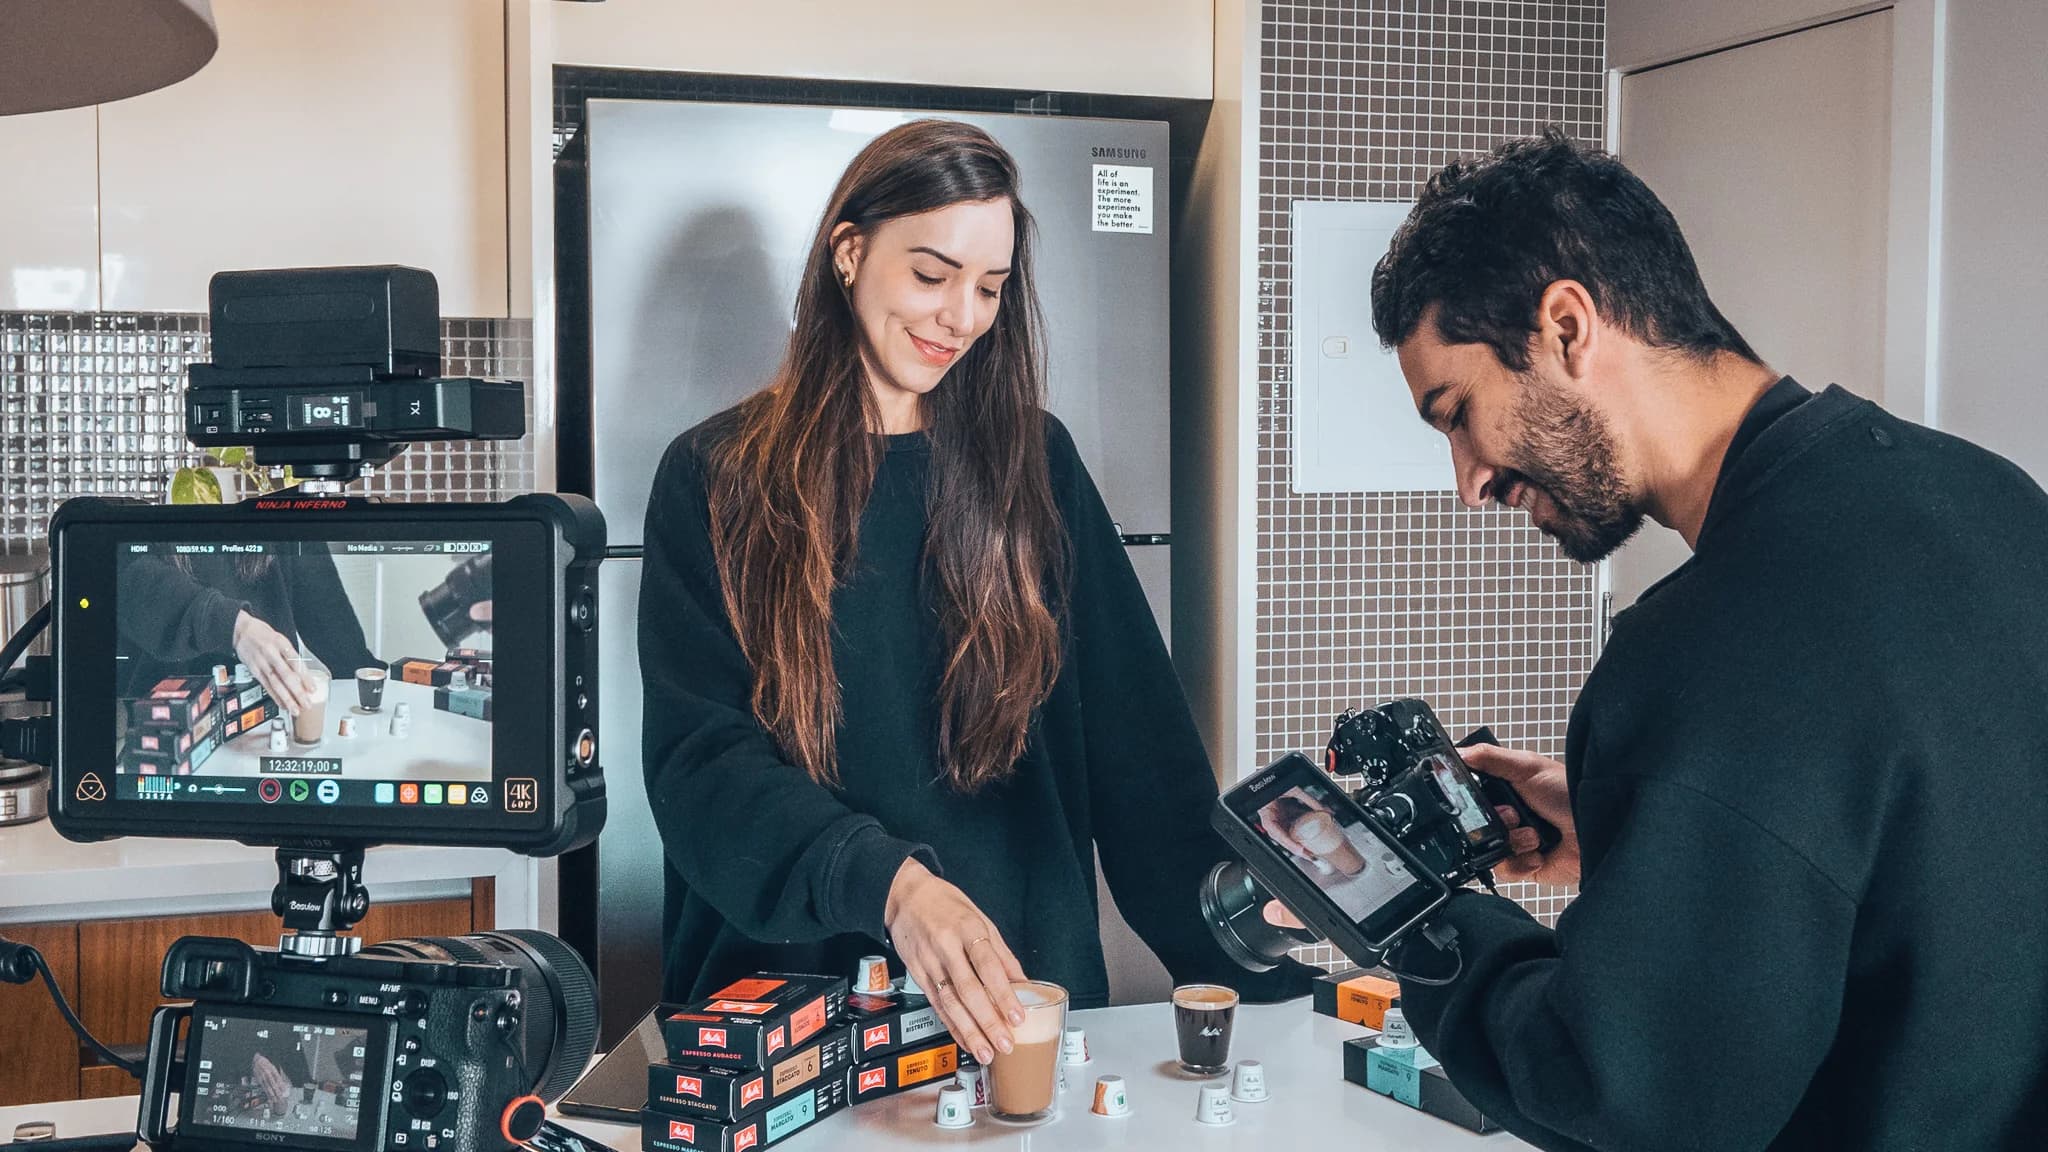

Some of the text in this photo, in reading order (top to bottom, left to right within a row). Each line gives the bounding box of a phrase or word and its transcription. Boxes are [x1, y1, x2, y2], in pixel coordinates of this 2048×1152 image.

[1091, 147, 1147, 159] SAMSUNG
[410, 400, 420, 416] TX
[256, 500, 347, 509] NINJA INFERNO
[510, 784, 531, 799] 4K
[360, 996, 378, 1005] MENU
[906, 1020, 933, 1032] RISTRETTO
[406, 1041, 416, 1050] Fn
[682, 1049, 711, 1057] ESPRESSO
[808, 1061, 813, 1072] 6
[942, 1056, 948, 1068] 5
[906, 1065, 928, 1076] TENUTO
[660, 1096, 716, 1110] ESPRESSO STACCATO
[802, 1104, 807, 1116] 9
[213, 1114, 234, 1124] 1/160
[256, 1132, 286, 1143] SONY
[442, 1128, 454, 1138] C3
[653, 1140, 680, 1150] ESPRESSO
